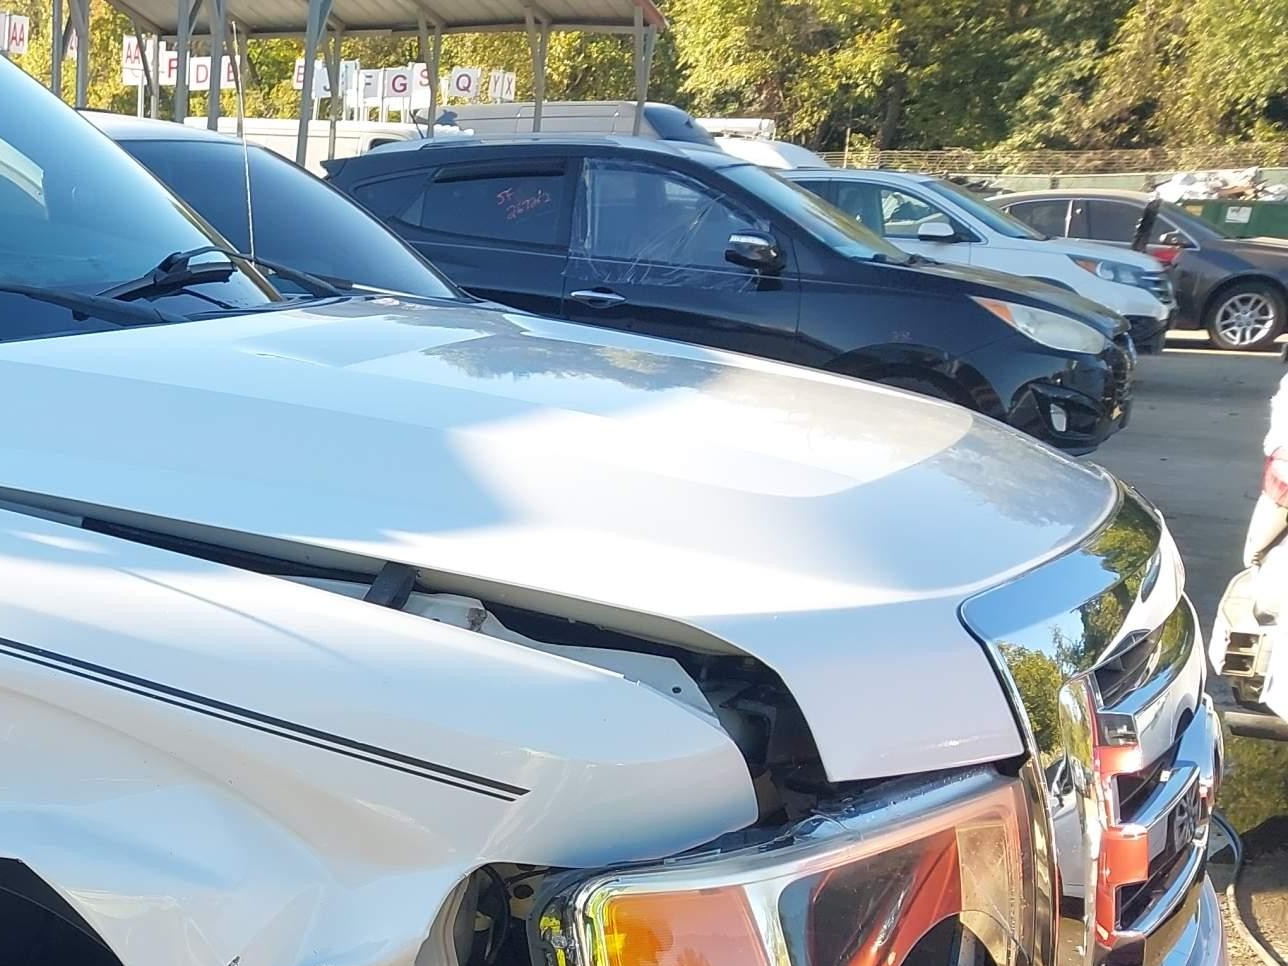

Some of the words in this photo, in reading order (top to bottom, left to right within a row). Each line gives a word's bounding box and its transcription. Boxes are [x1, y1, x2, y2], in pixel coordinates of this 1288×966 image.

[196, 64, 210, 84] D
[391, 74, 409, 94] G
[455, 73, 472, 93] Q
